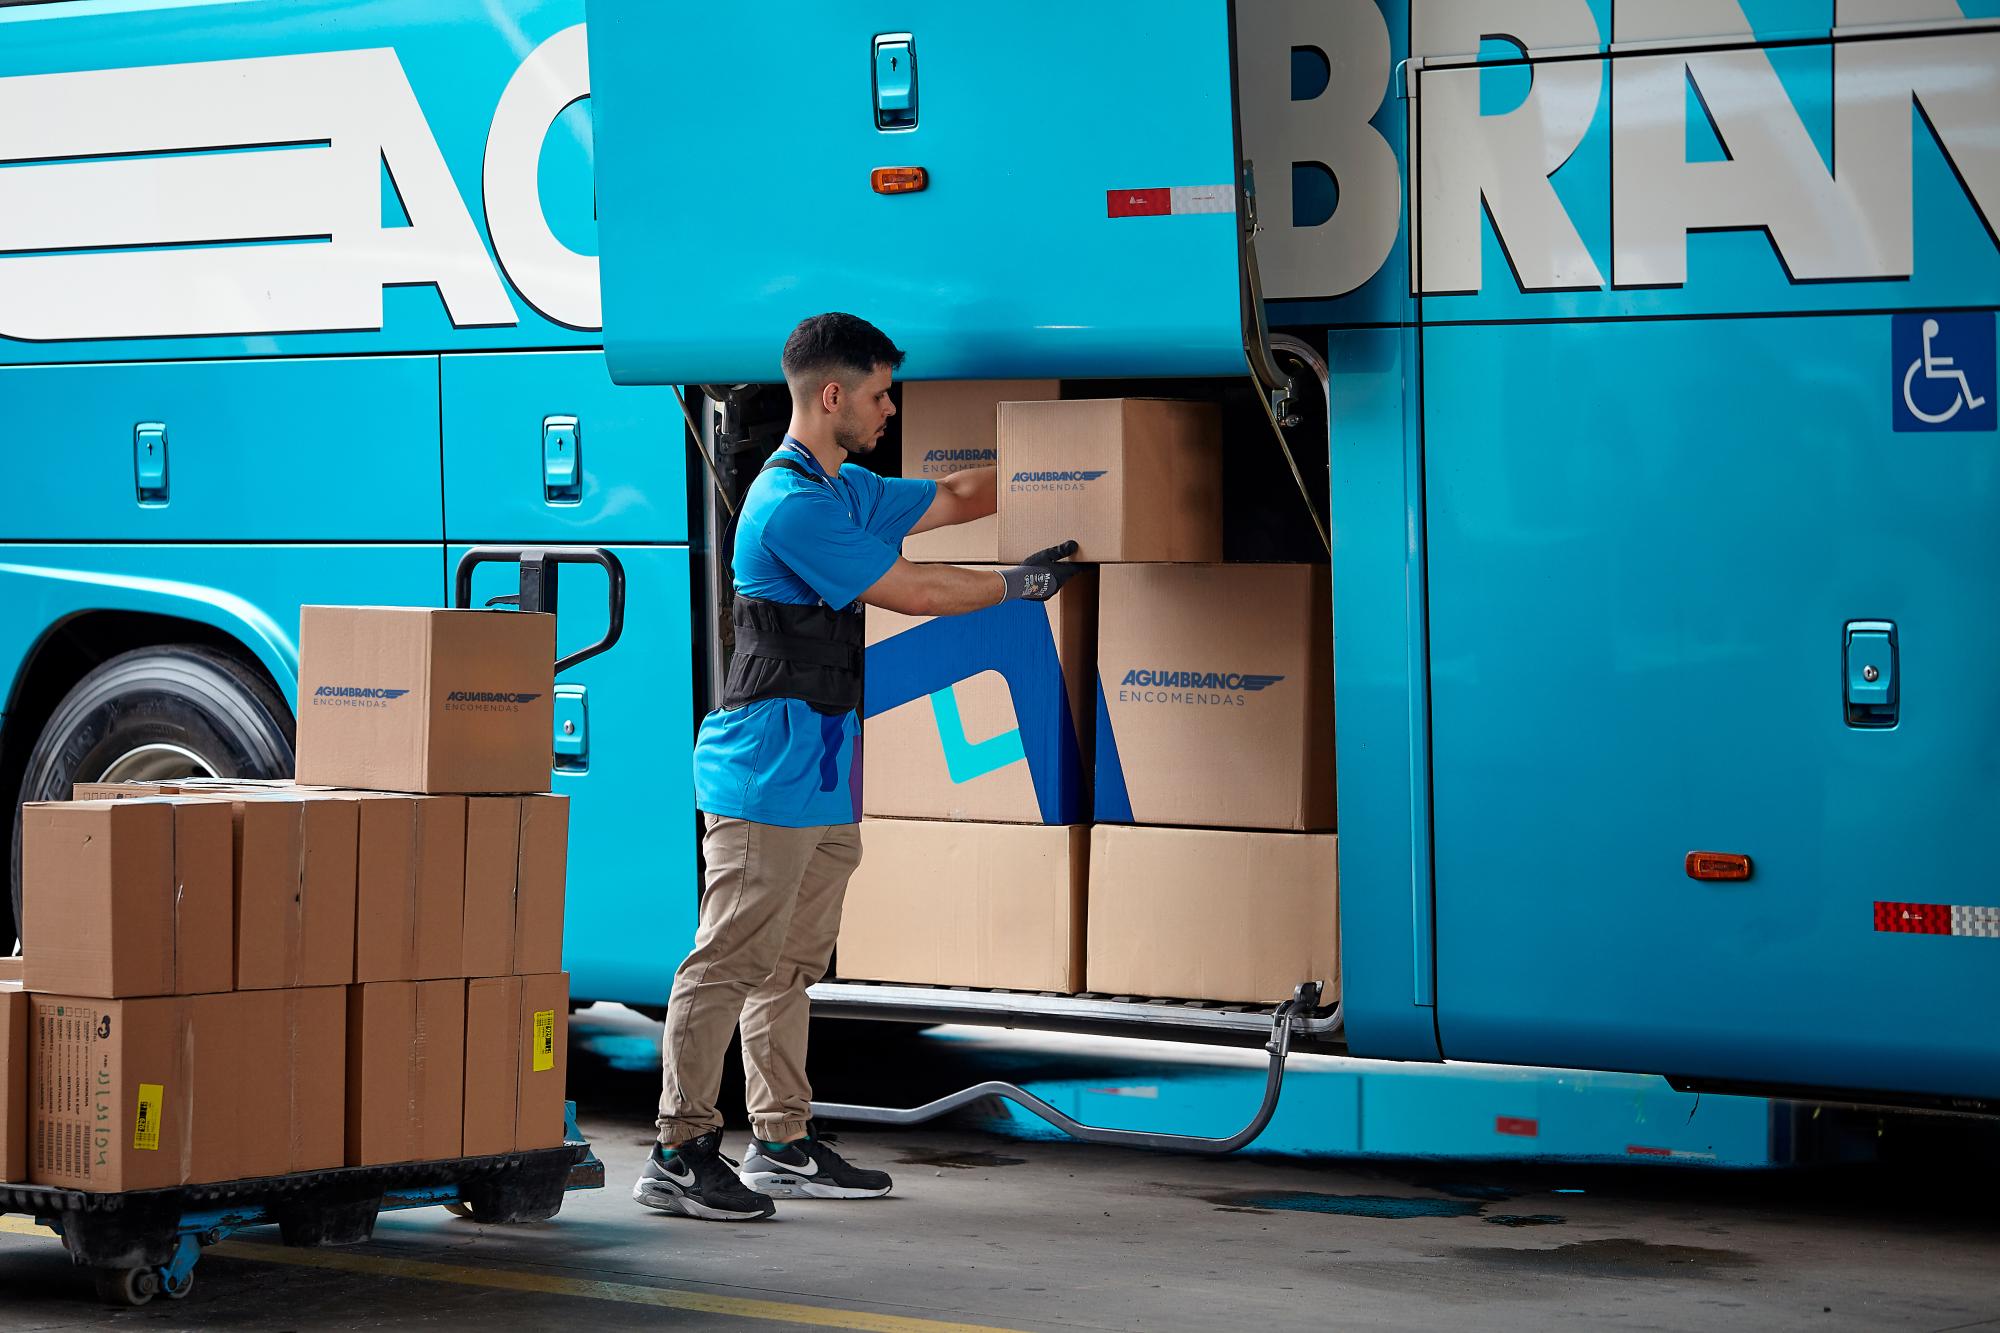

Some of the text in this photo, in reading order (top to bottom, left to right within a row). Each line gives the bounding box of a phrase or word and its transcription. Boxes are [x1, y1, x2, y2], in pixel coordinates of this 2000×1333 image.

[924, 449, 997, 462] AGUIABRAN
[922, 464, 994, 473] ENCOME
[1011, 470, 1108, 483] AGUIABRANCA
[1010, 483, 1086, 492] ENCOMENDAS
[1120, 669, 1285, 691] AGUIABRANCA
[314, 686, 410, 699] AGUIABRANCA
[447, 691, 543, 703] AGUIABRANCA
[1119, 690, 1245, 706] ENCOMENDAS
[313, 698, 387, 708] ENCOMENDAS
[445, 703, 519, 713] ENCOMENDAS
